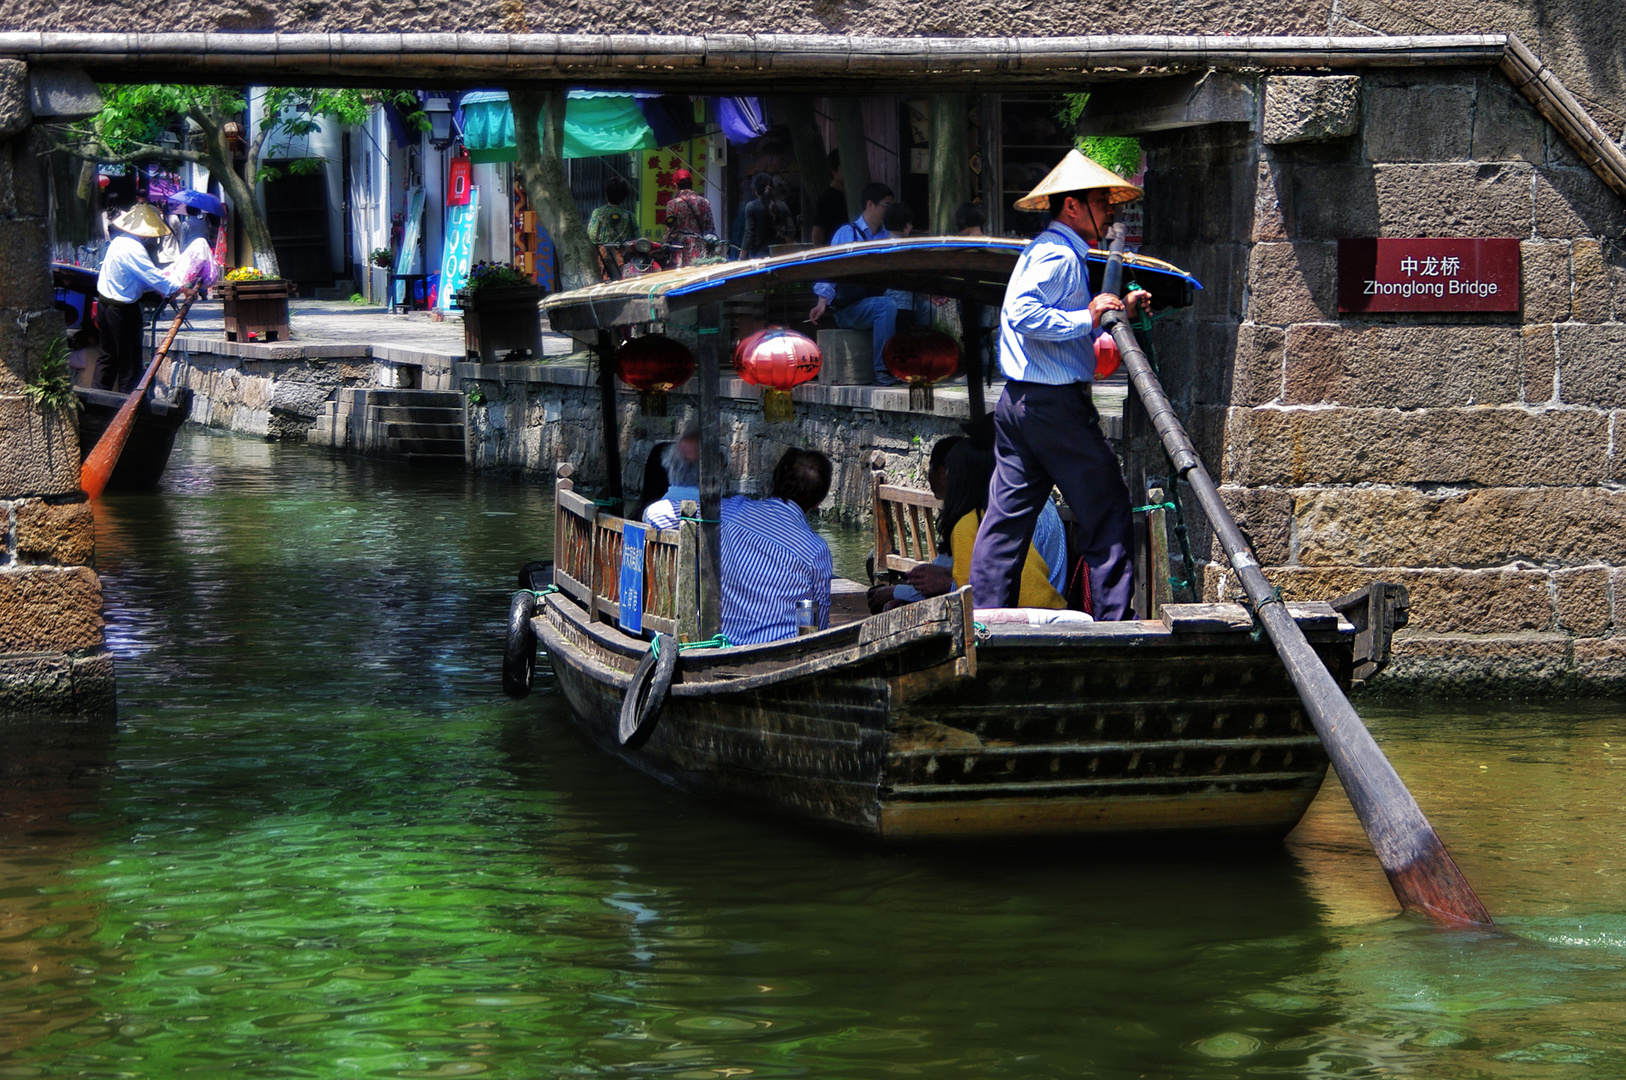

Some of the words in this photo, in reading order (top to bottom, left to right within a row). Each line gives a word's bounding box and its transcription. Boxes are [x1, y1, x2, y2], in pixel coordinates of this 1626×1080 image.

[1400, 256, 1461, 277] 中龙桥
[1363, 280, 1444, 298] Zhonglong
[1449, 280, 1498, 298] Bridge
